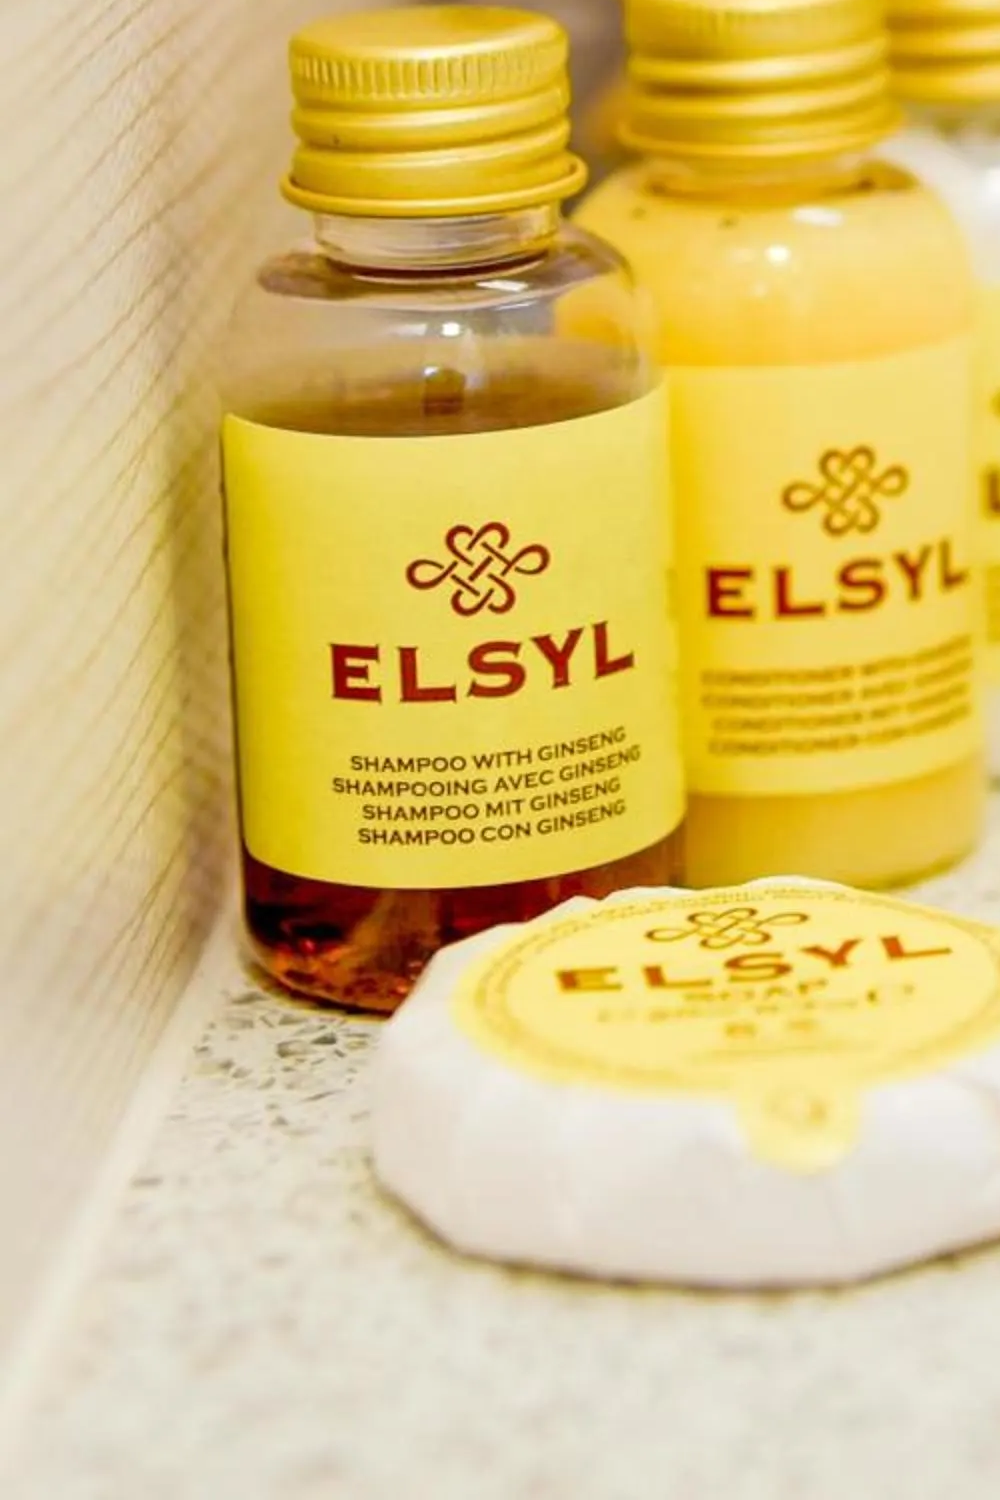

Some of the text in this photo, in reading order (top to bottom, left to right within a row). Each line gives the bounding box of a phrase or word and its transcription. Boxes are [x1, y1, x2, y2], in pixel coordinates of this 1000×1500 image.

[704, 536, 970, 620] ELSYL
[329, 620, 635, 705] ELSYL
[332, 744, 642, 798] SHAMPOOING AVEC GINSENG
[350, 726, 627, 773] SHAMPOO WITH GINSENG
[357, 798, 626, 847] SHAMPOO CON GINSENG
[362, 777, 622, 821] SHAMPOO MIT GINSENG
[554, 934, 954, 994] ELSYL
